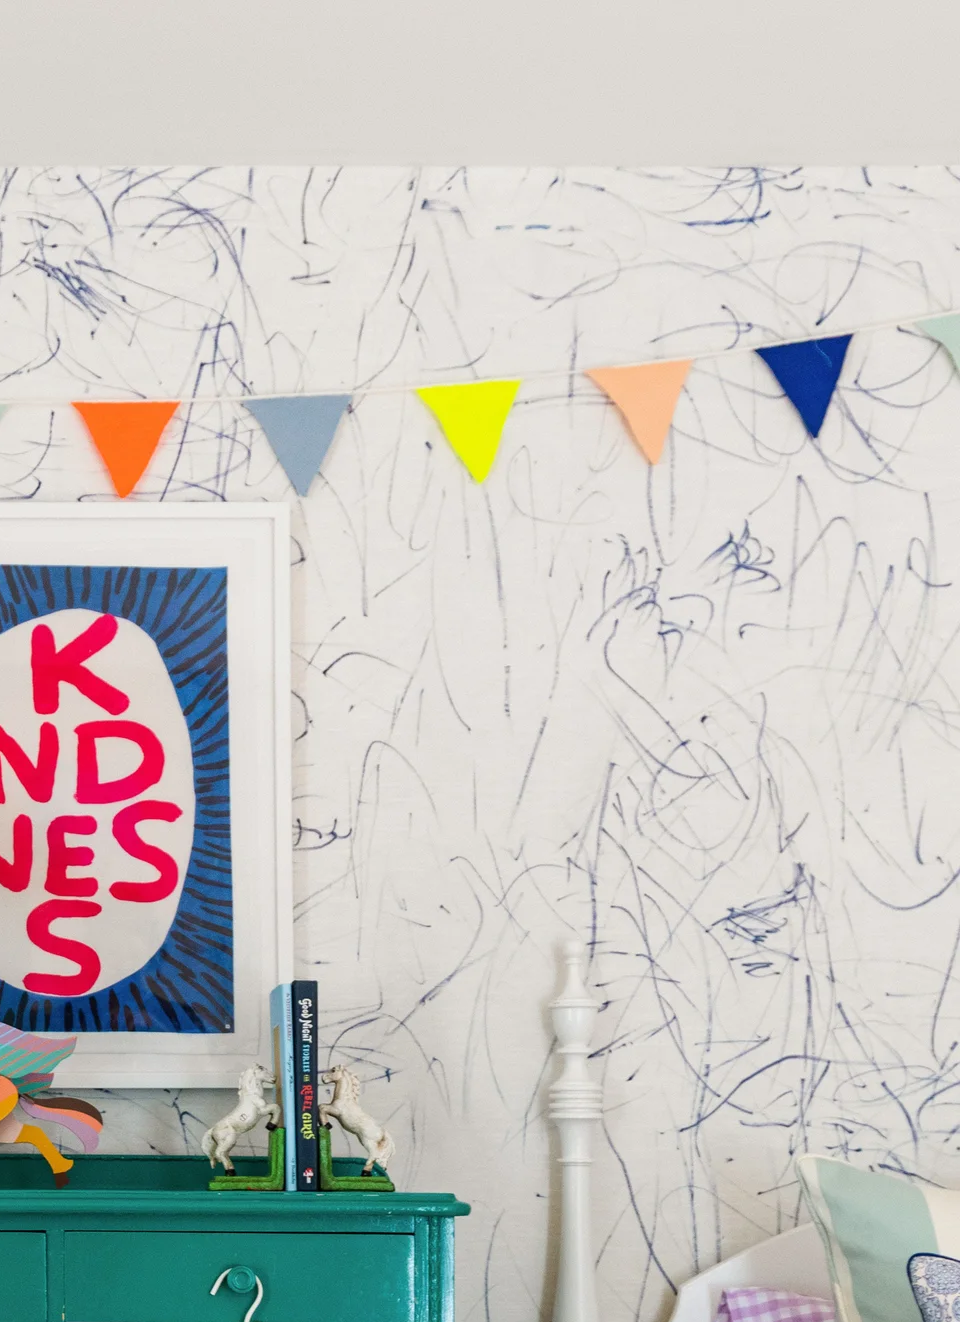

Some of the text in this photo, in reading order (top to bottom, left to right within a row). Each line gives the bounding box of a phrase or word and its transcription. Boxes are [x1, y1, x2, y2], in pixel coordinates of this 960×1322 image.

[30, 613, 130, 715] K
[22, 899, 102, 997] S
[300, 1084, 313, 1111] REBEL
[300, 1112, 316, 1140] GIRLS
